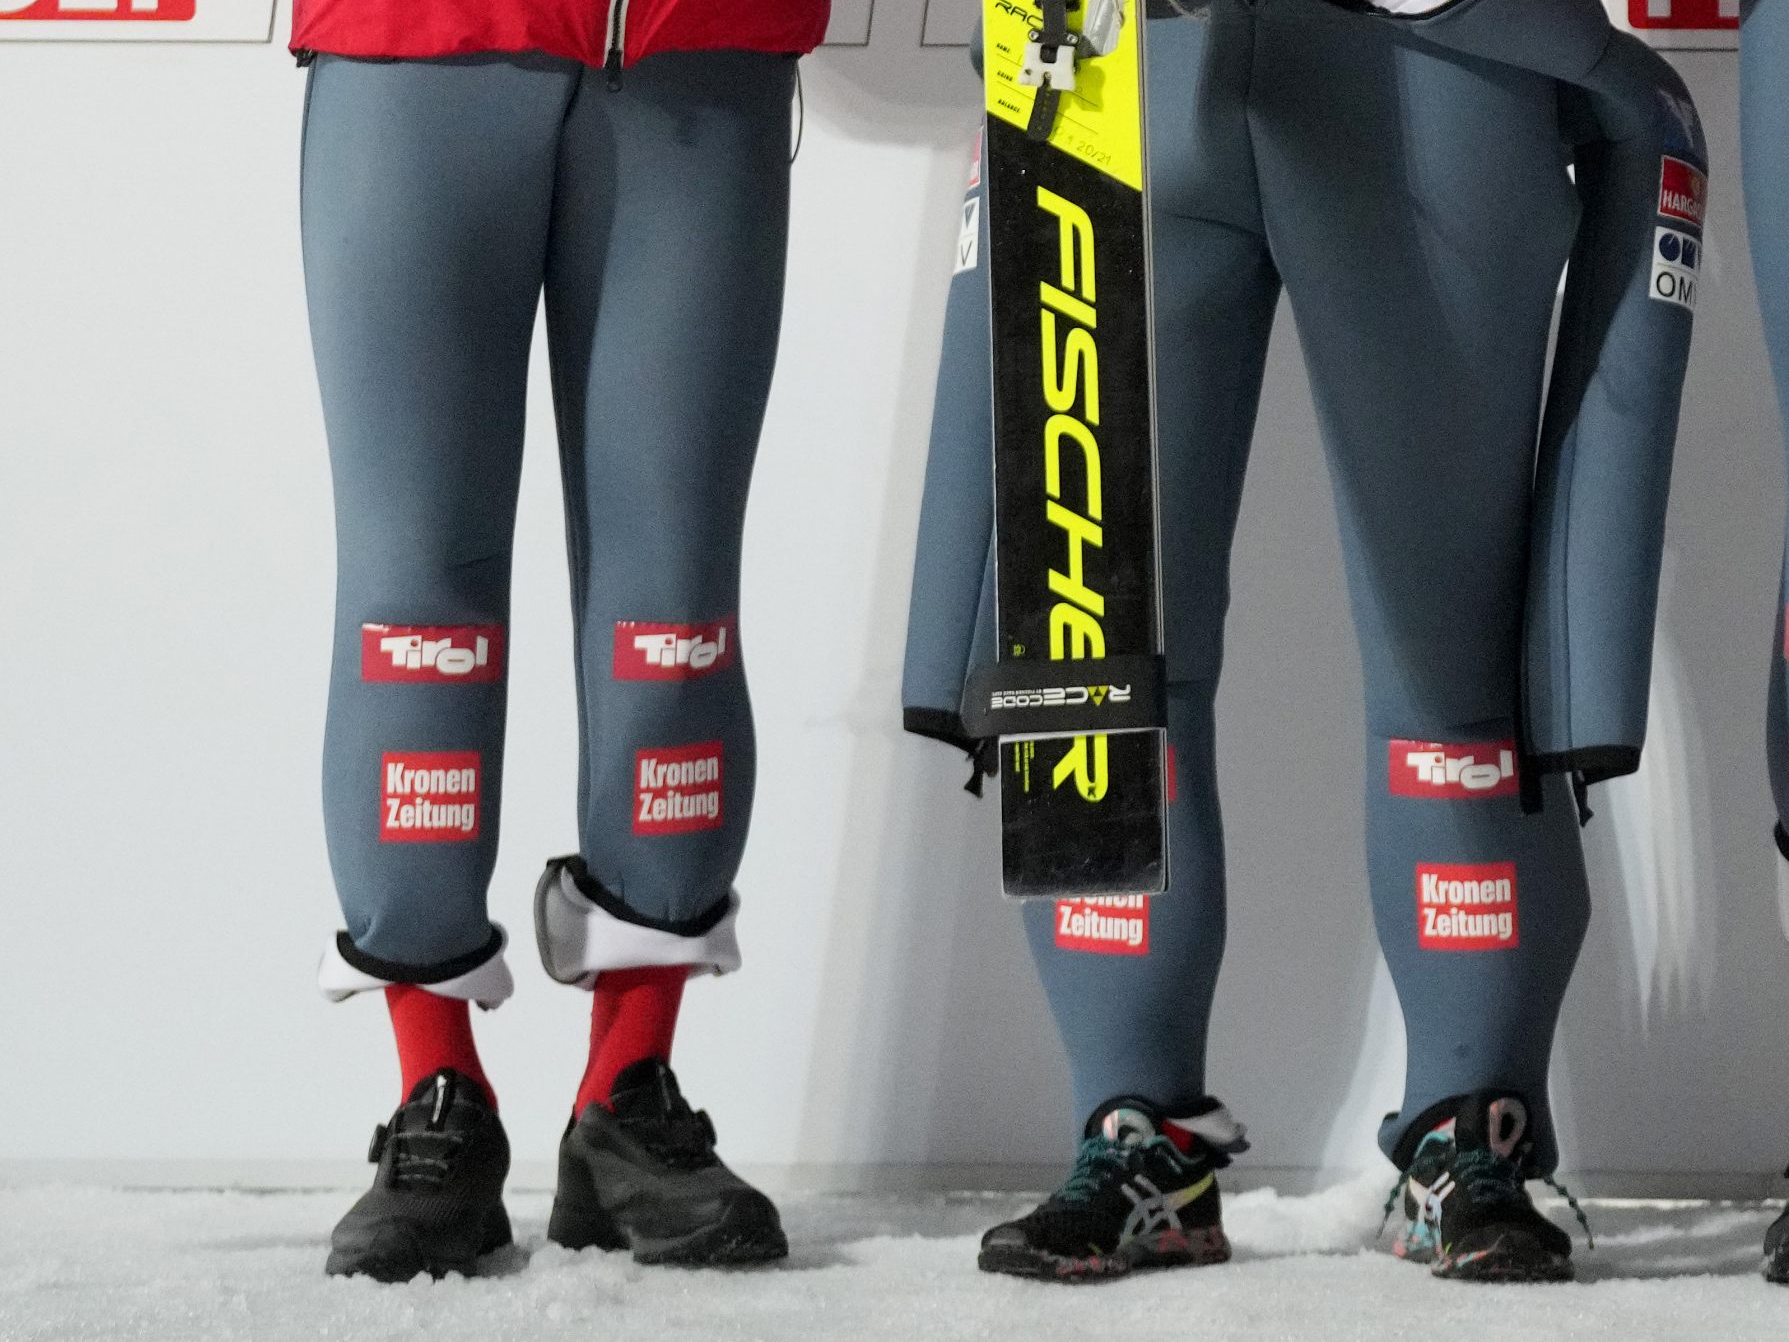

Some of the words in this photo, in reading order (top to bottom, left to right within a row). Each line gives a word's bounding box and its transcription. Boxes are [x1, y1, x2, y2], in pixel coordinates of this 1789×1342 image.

[380, 633, 488, 674] Tirol
[634, 626, 726, 670] Tirol
[386, 762, 475, 795] Kronen
[640, 756, 719, 789] Kronen
[1406, 749, 1514, 789] Tirol
[386, 797, 475, 831] Zeitung
[639, 789, 720, 823] Zeitung
[1421, 873, 1511, 905] Kronen
[1059, 909, 1144, 946] Zeitung
[1423, 907, 1513, 941] Zeitung
